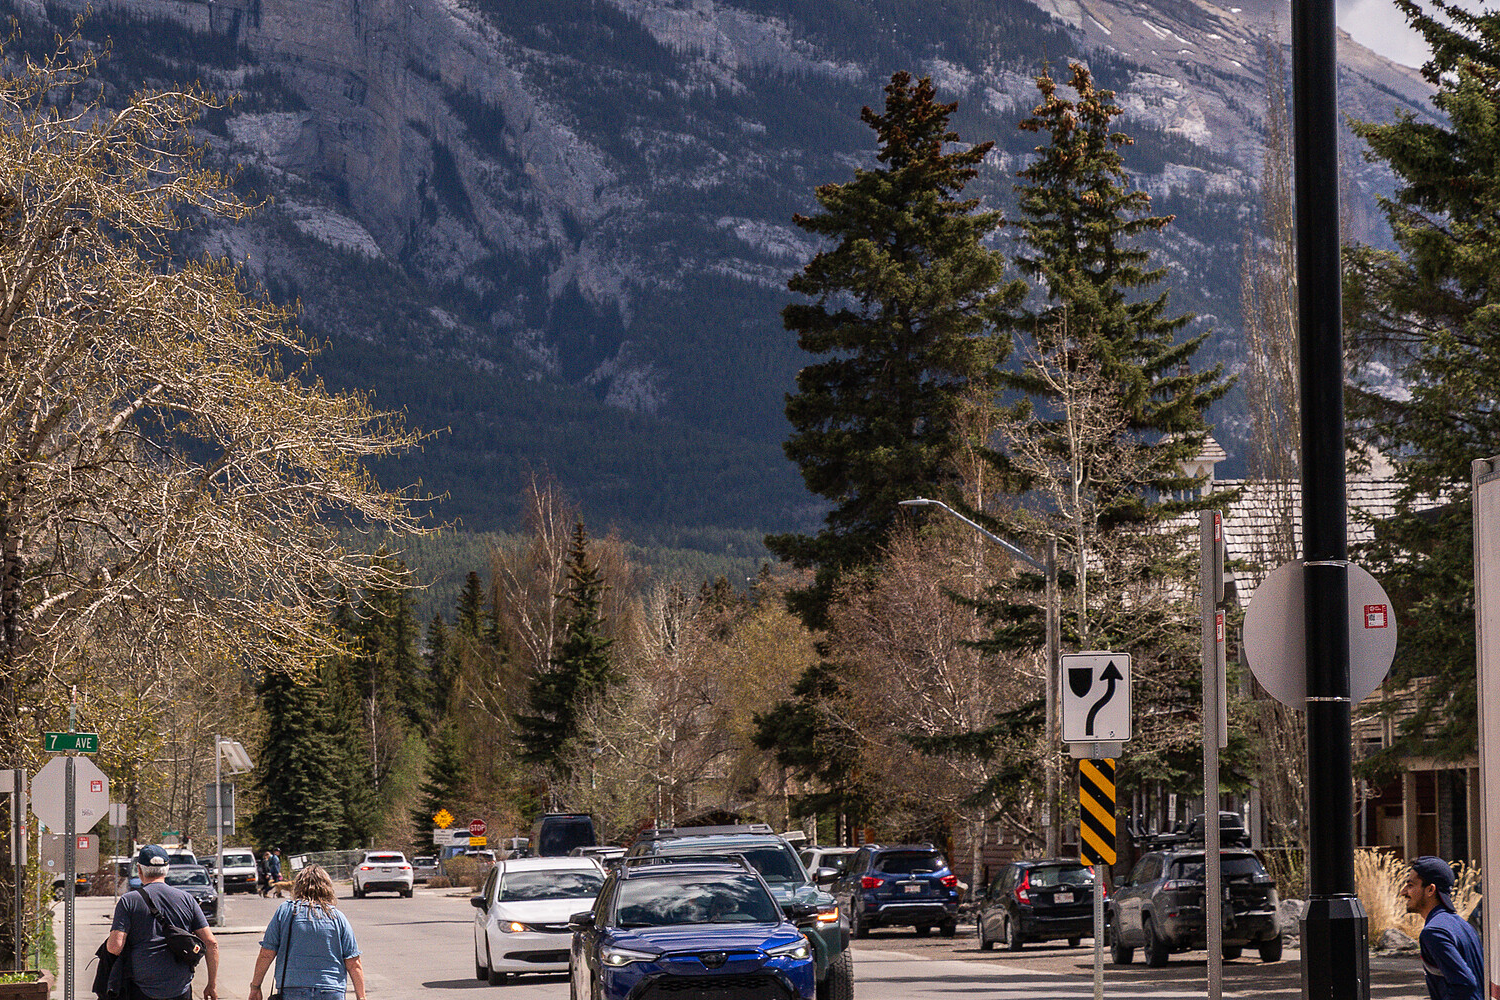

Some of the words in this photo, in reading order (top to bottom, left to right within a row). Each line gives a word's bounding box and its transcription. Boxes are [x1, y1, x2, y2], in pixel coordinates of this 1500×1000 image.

[50, 735, 58, 749] 7
[75, 737, 92, 749] AVE
[470, 824, 486, 832] STOP
